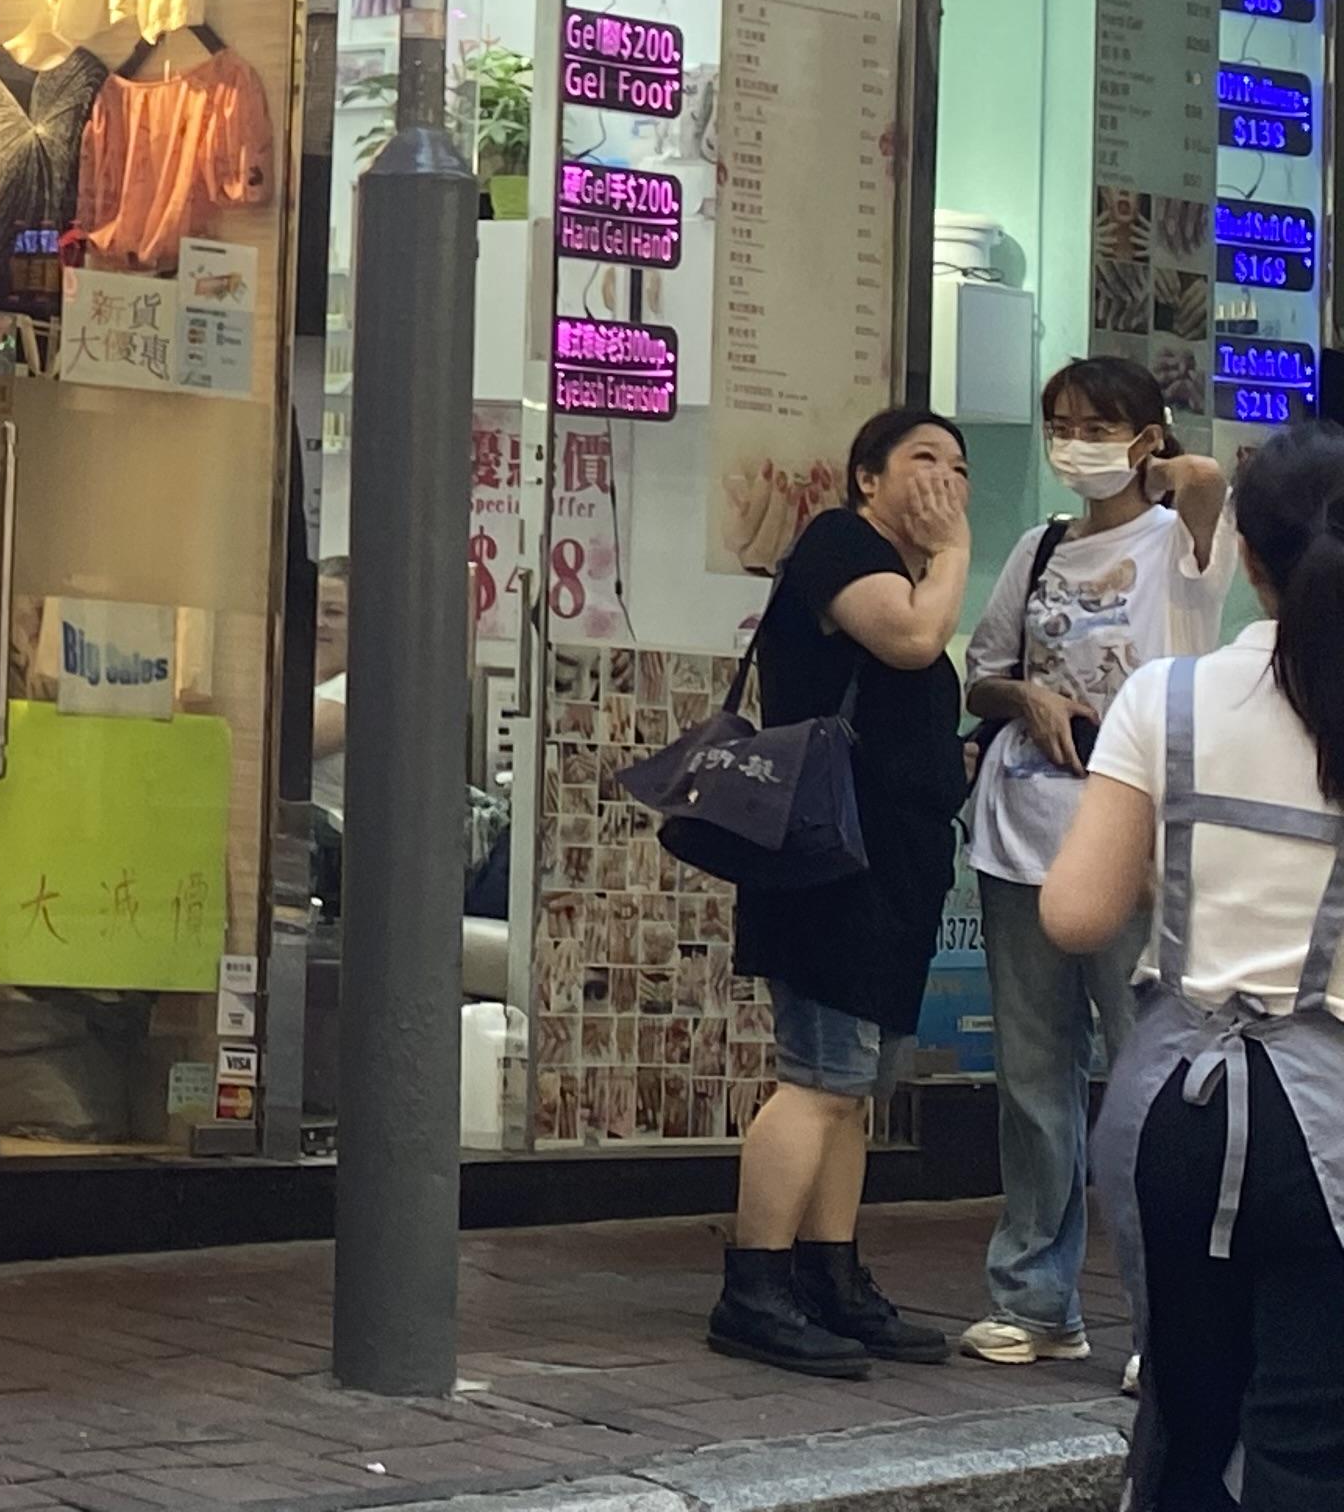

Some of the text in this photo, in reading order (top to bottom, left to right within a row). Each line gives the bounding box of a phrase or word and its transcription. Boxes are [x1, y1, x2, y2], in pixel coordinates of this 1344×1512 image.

[565, 62, 674, 111] Gel Foot
[561, 222, 672, 262] Hard Gel Hand
[89, 289, 163, 333] 新貨
[62, 620, 100, 686] Big
[226, 1054, 252, 1071] VISA
